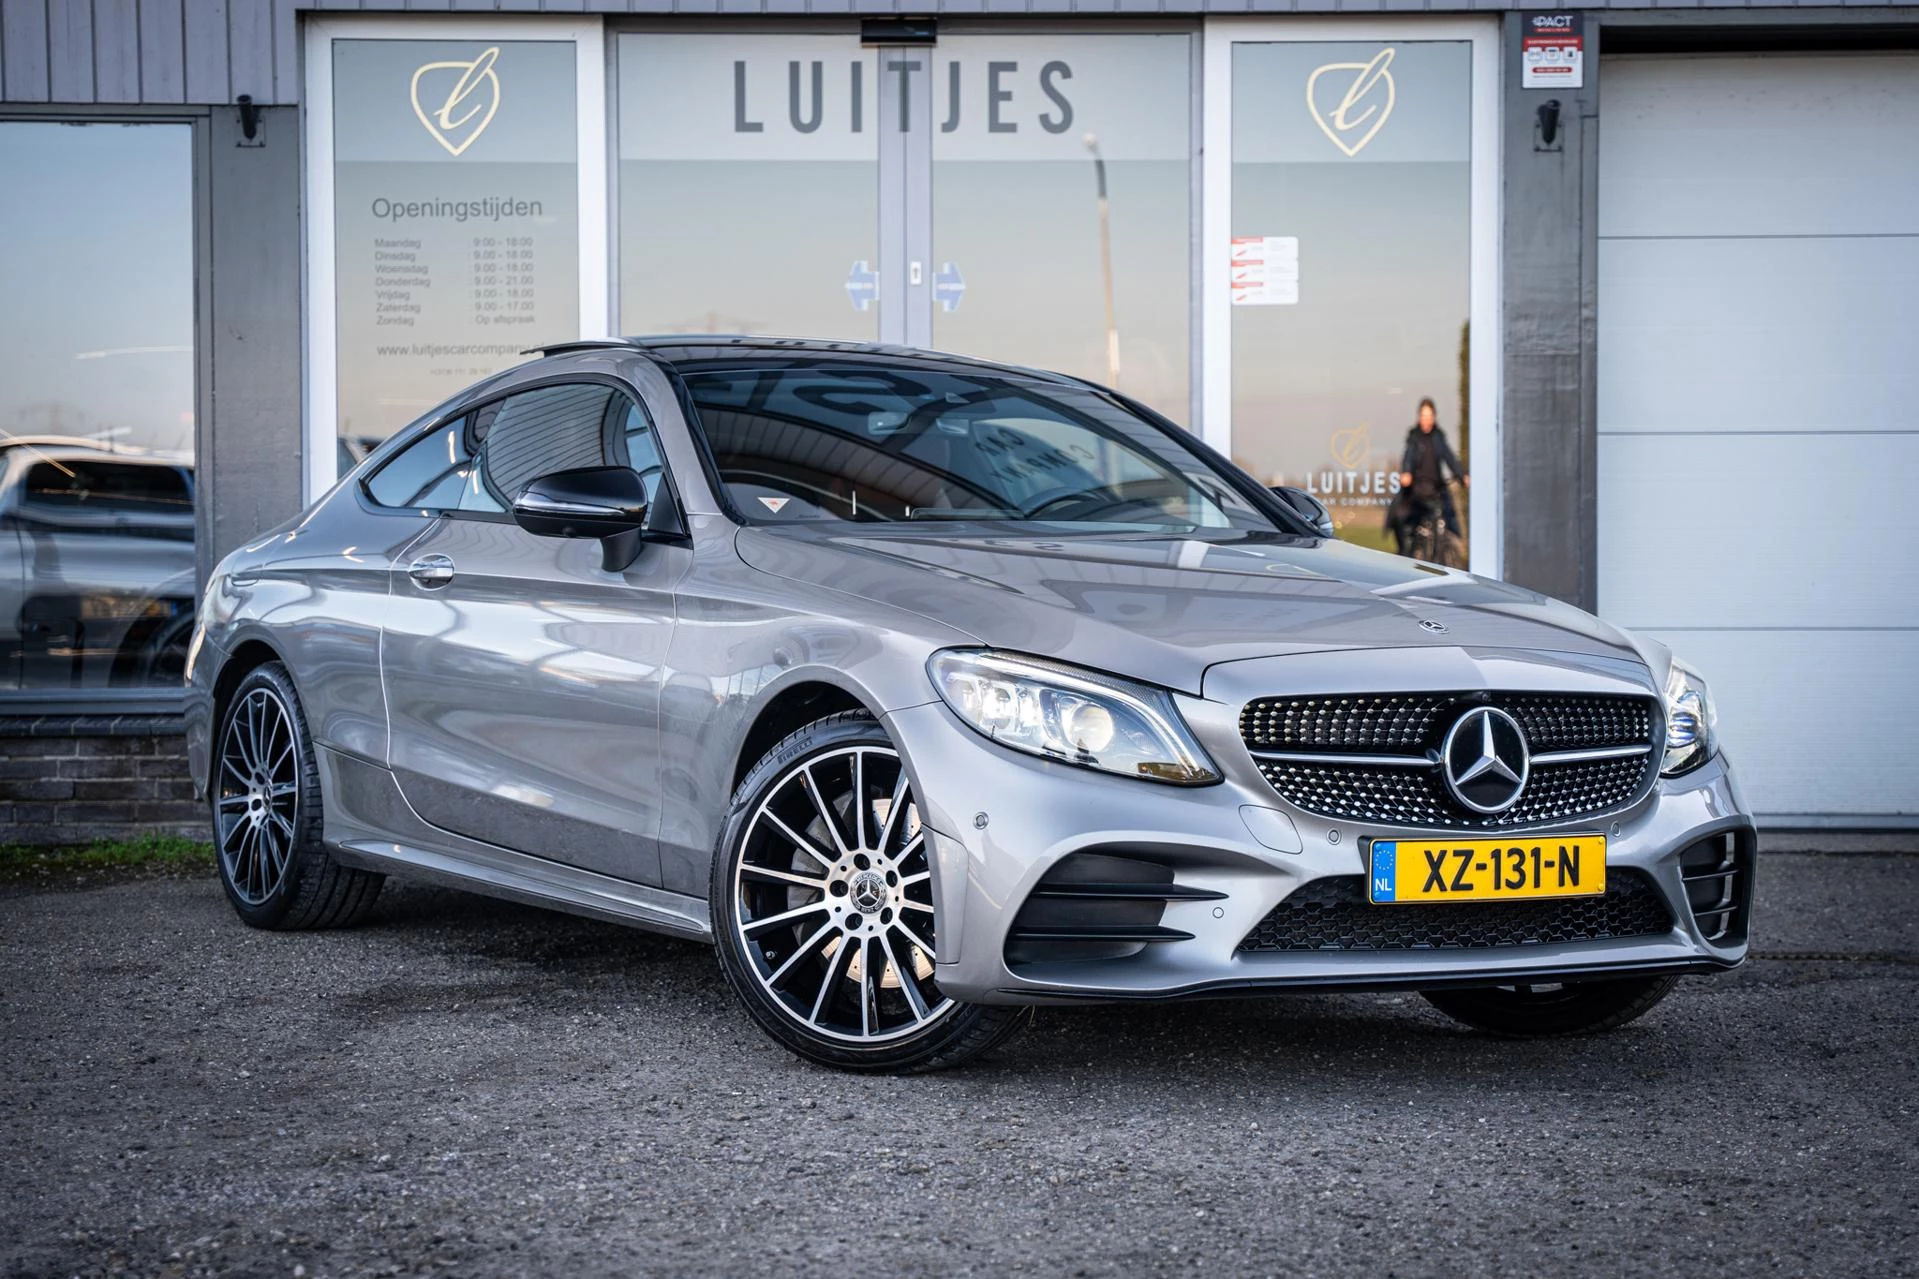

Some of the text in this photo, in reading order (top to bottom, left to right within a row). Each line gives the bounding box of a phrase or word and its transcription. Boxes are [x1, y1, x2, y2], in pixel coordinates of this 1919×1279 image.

[734, 60, 1074, 134] LUITJES
[372, 197, 542, 222] Openingstijden
[375, 238, 422, 249] Maandag
[375, 251, 416, 262] Dinsdag
[375, 264, 429, 275] Woensdag
[375, 276, 431, 288] Donderdag
[375, 289, 411, 301] Vrijdag
[376, 302, 421, 313] Zaterdag
[376, 315, 415, 327] Zondag
[1306, 471, 1401, 494] LUITJES
[1422, 845, 1580, 893] XZ-131-N
[1375, 878, 1392, 892] NL
